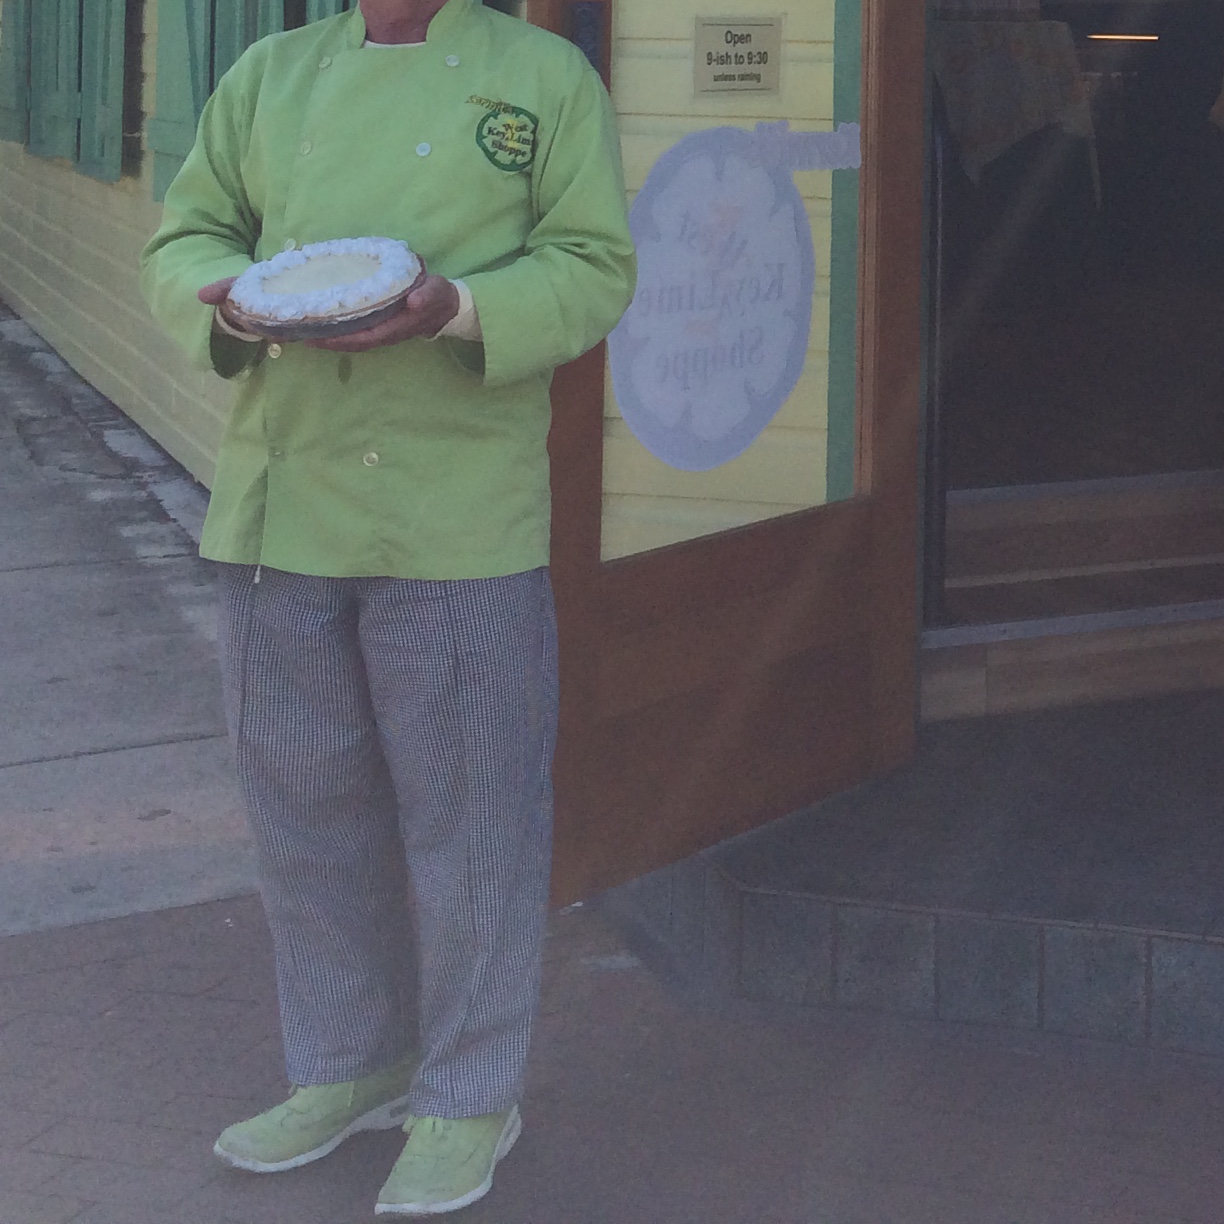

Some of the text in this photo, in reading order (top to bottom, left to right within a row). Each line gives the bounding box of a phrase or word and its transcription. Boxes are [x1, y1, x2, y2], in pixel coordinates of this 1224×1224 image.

[724, 30, 752, 47] Open
[706, 51, 769, 66] 9-ish to 9:30
